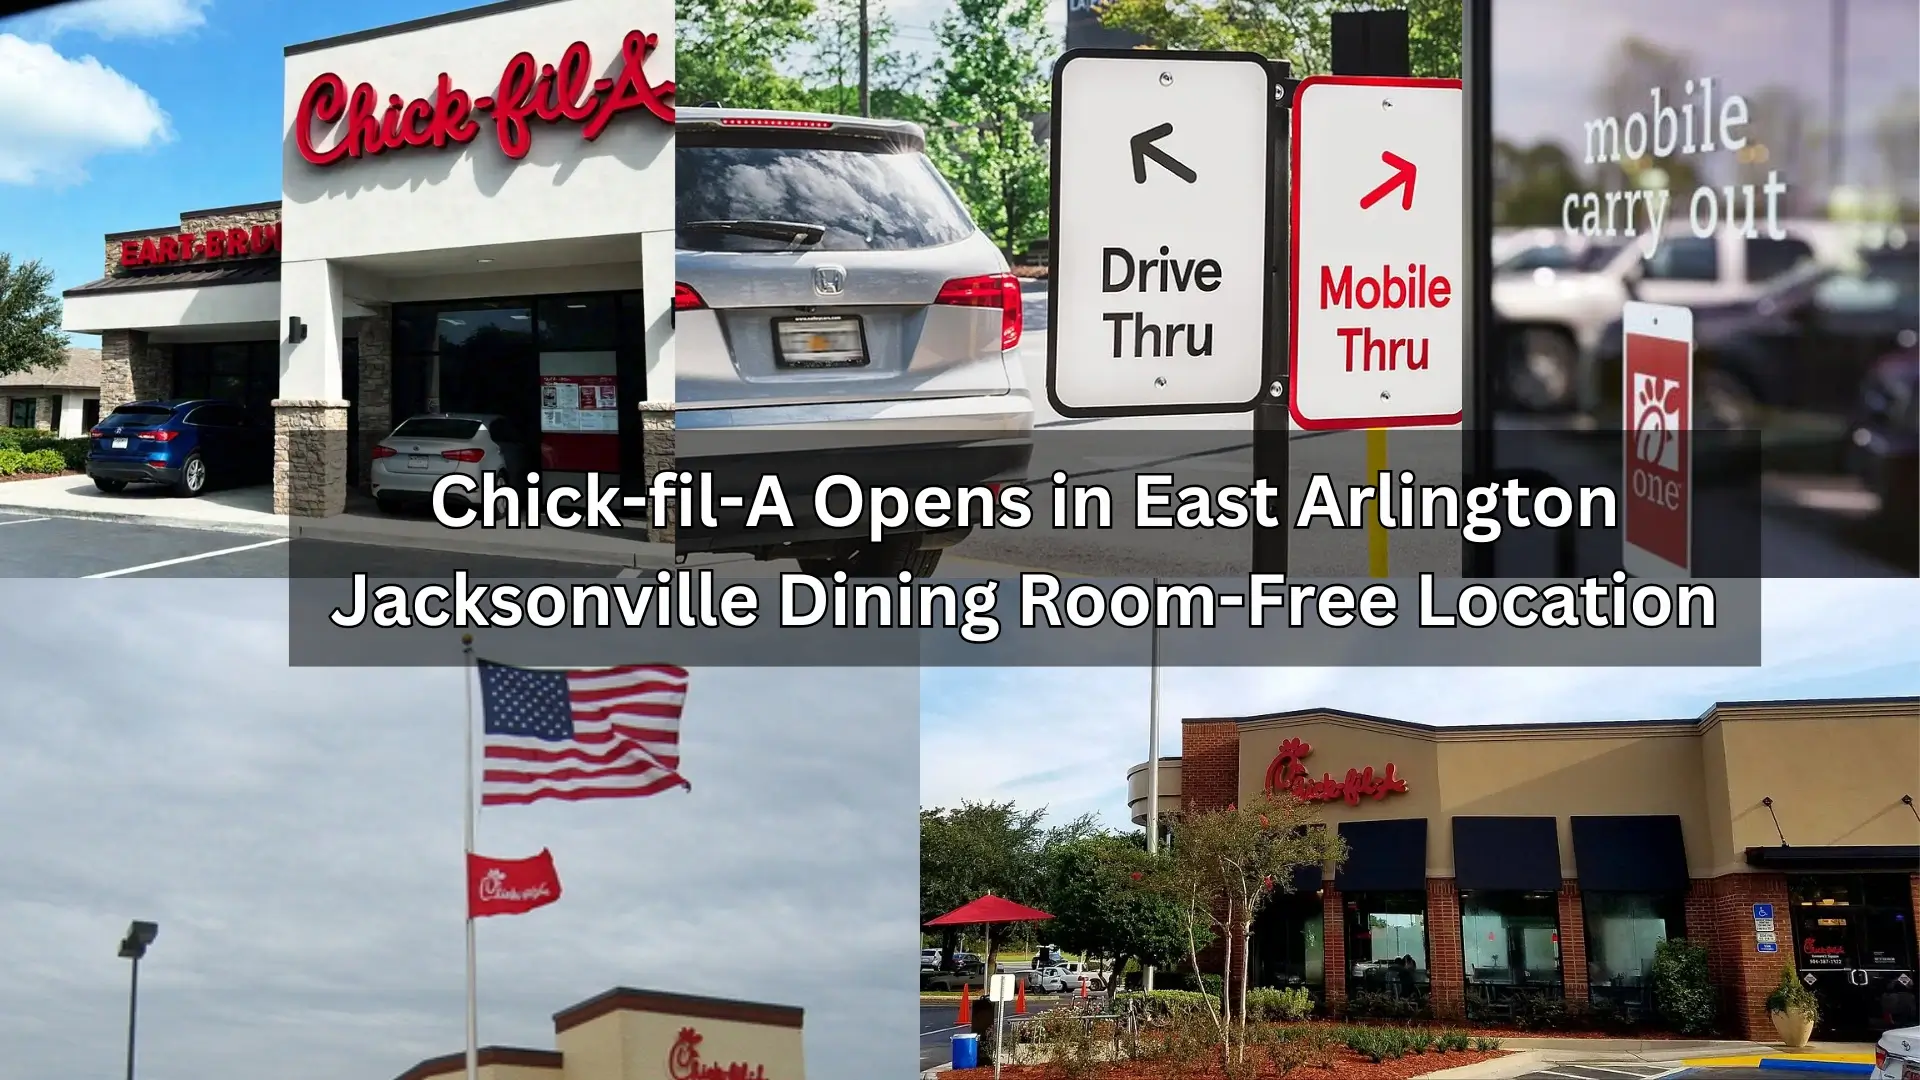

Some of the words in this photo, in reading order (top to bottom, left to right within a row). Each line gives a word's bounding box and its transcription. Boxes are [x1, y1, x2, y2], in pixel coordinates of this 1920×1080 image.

[296, 29, 675, 166] Chick-fil-A
[1583, 77, 1749, 165] mobile
[1562, 189, 1670, 260] carry
[1690, 170, 1788, 241] out
[1101, 245, 1222, 293] Drive
[1320, 263, 1452, 310] Mobile
[1102, 311, 1214, 358] Thru
[1337, 327, 1430, 372] Thru
[1632, 467, 1681, 511] one
